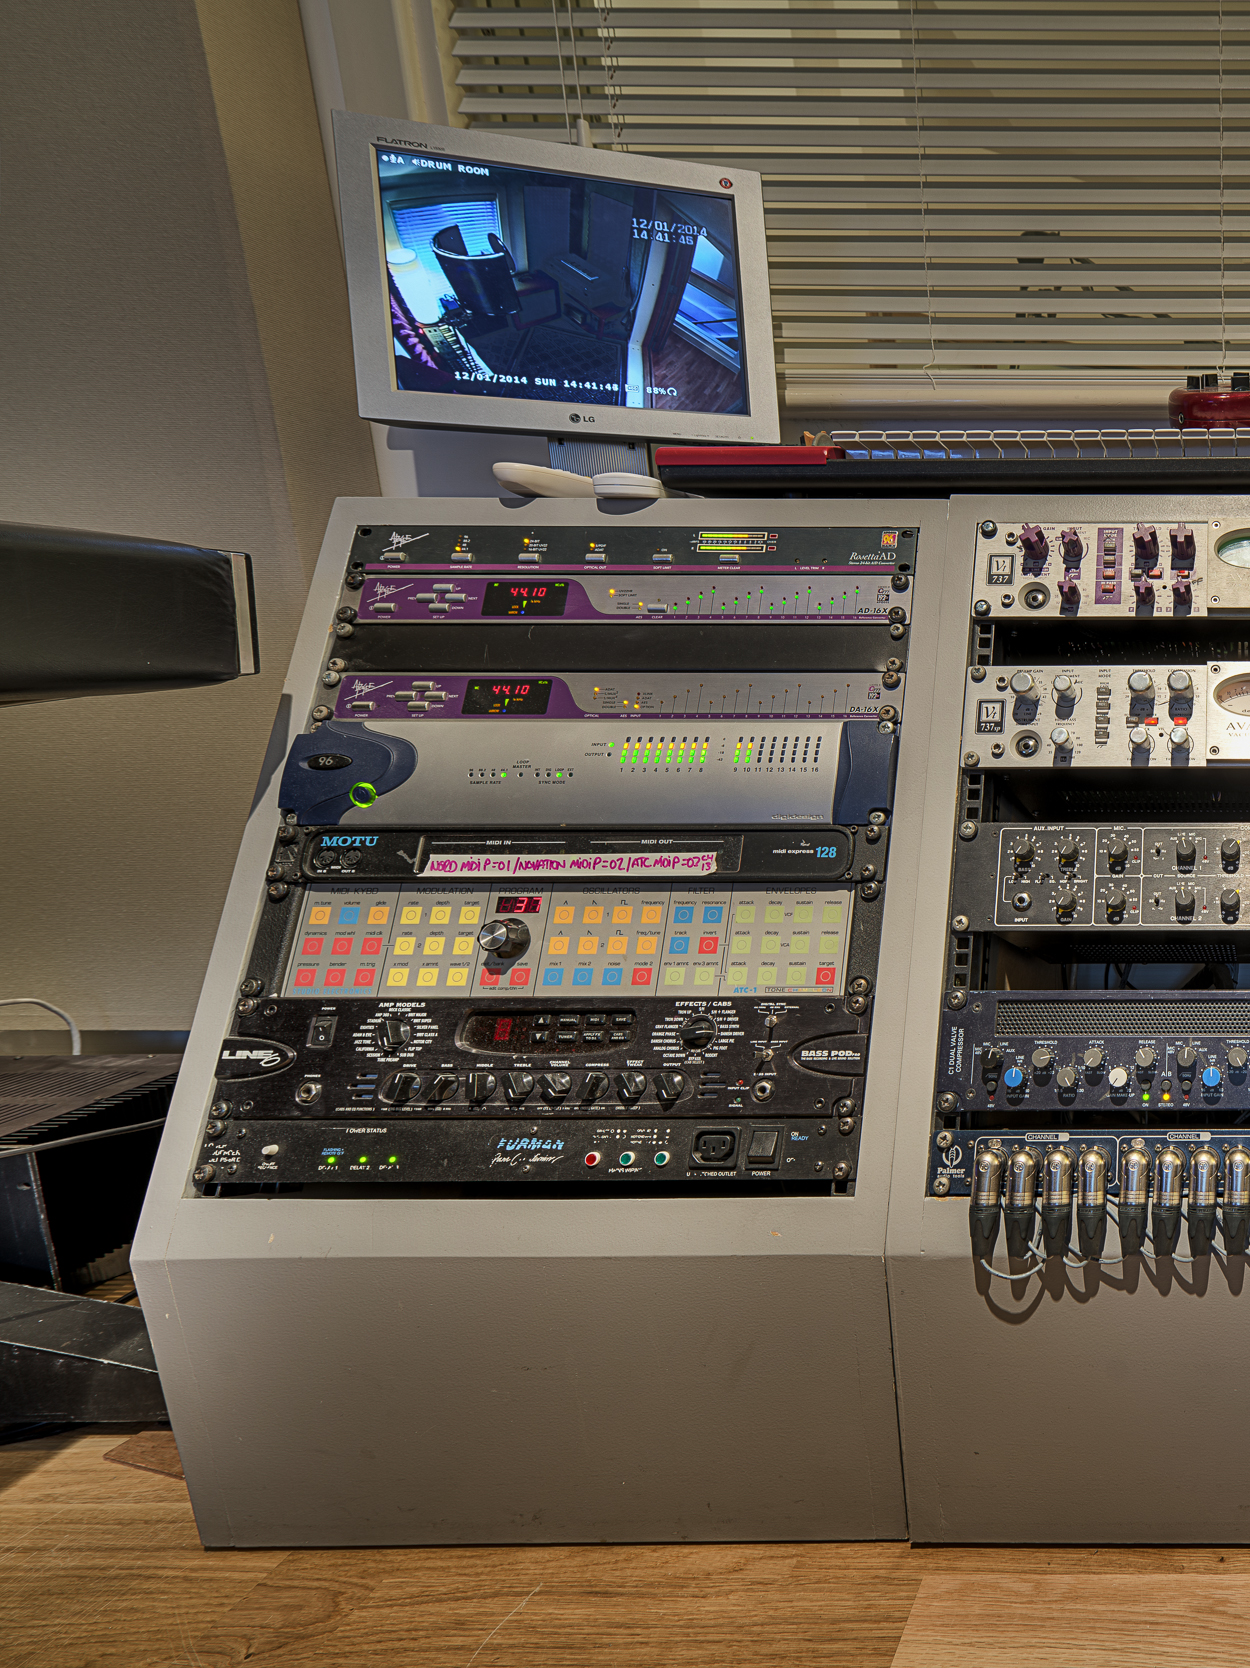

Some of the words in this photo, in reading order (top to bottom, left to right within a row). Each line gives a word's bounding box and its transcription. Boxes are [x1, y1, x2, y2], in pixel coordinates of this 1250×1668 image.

[377, 137, 427, 149] FLATRON
[421, 160, 452, 171] DRUM
[458, 165, 489, 176] ROOM
[632, 218, 707, 236] 12/01/2014
[454, 371, 527, 385] 12/01/2014
[535, 377, 556, 387] SUN
[583, 415, 595, 423] LG
[318, 756, 334, 766] 96
[320, 836, 378, 846] MOTU
[816, 846, 837, 858] 128
[950, 1026, 958, 1047] VALVE
[221, 1050, 274, 1060] LINE
[955, 1028, 965, 1073] COMPRESSOR
[497, 1137, 565, 1150] FURMAN
[937, 1167, 965, 1175] Palmer
